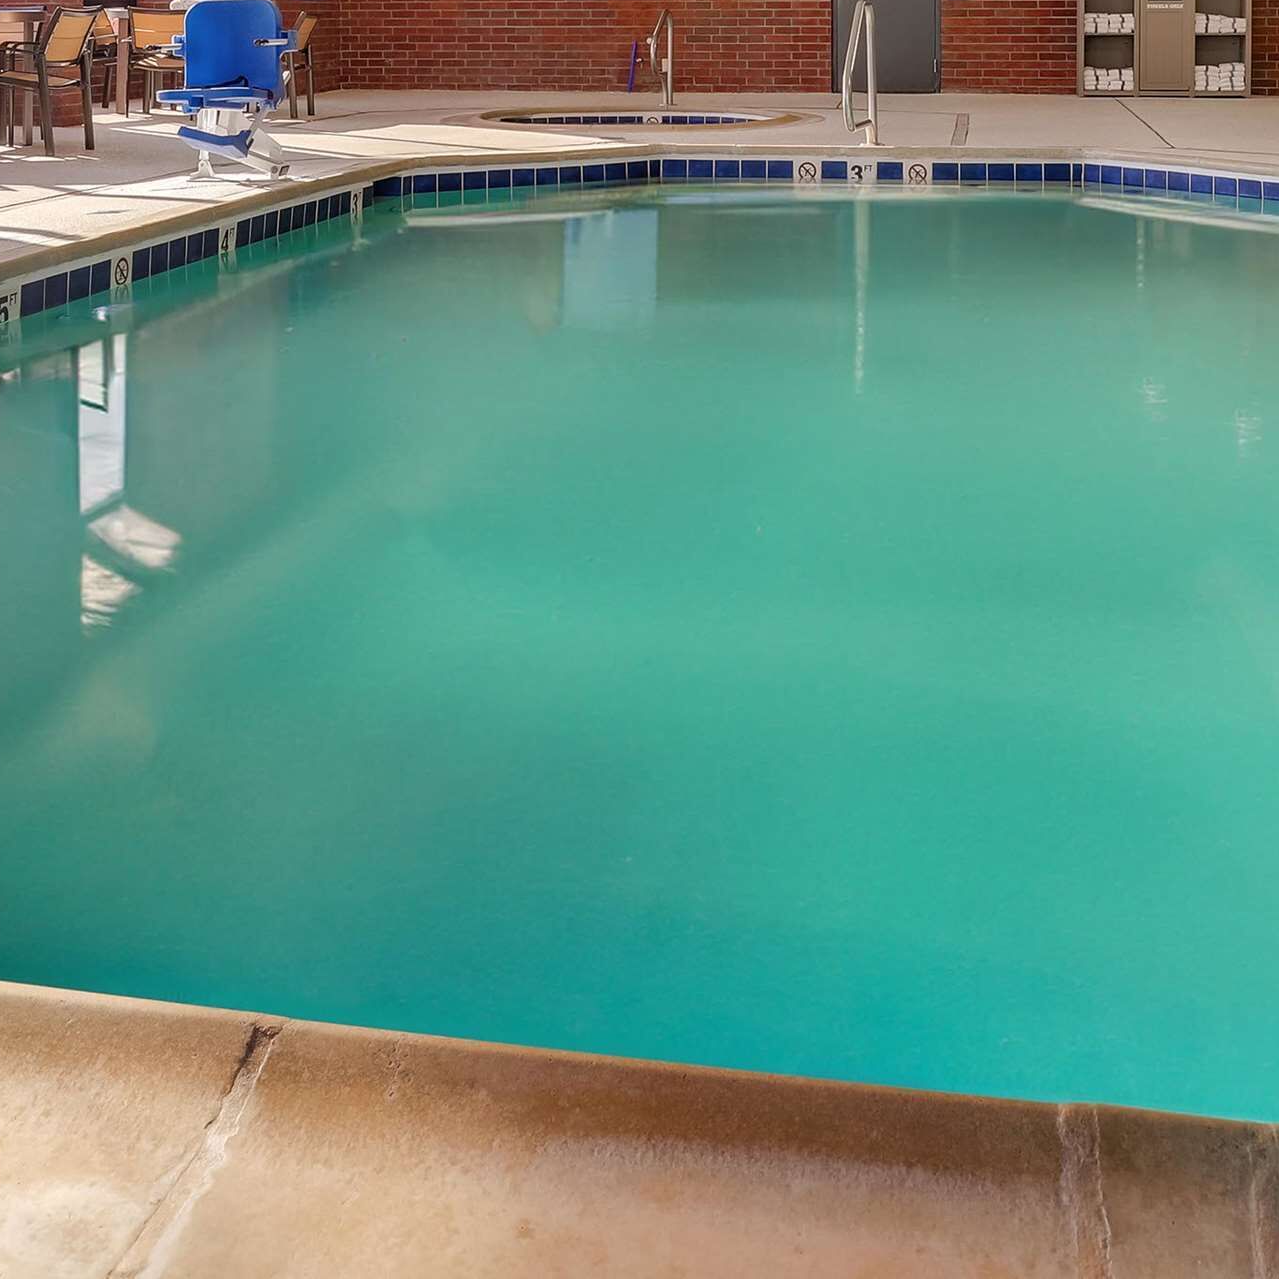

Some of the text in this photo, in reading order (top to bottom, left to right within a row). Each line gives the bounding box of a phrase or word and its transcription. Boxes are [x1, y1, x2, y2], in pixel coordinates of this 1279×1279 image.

[850, 164, 873, 180] 3 FT
[221, 227, 229, 252] 4
[9, 292, 18, 306] FT
